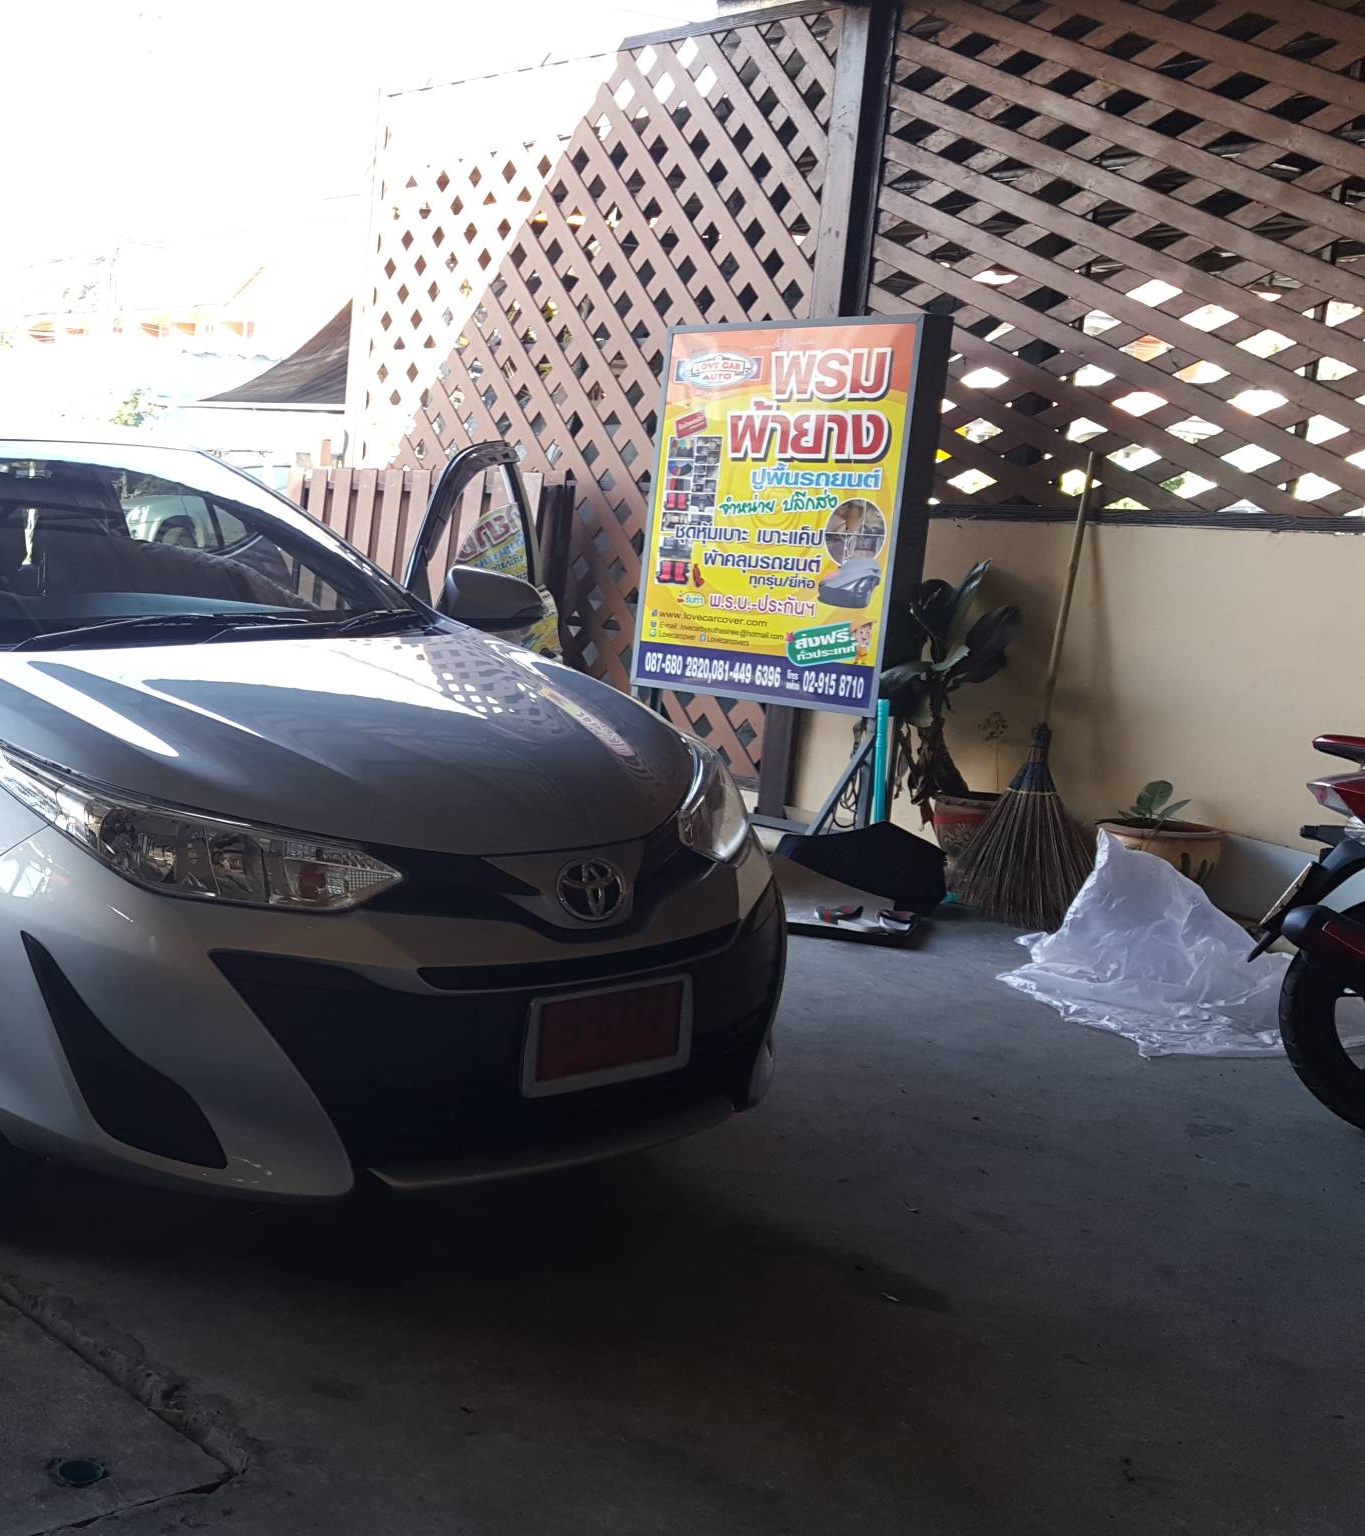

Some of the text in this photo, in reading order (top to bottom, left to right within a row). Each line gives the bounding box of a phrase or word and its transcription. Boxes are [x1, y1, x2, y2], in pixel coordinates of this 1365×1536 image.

[702, 373, 732, 381] AUTO
[772, 348, 891, 400] พรม
[729, 402, 890, 461] ผ้ายาง
[751, 463, 881, 490] ปูพื้นรถยนต์
[719, 489, 838, 515] จำหน่าย ปลีกส่ง
[675, 523, 824, 547] ชุดหุ้มเบาะ เบาะแค็ป
[704, 549, 822, 574] ผ้าคลุมรถยนต์
[749, 573, 816, 590] ทุกรุ่น/ยี่ห้อ
[659, 610, 768, 627] www.lovecarcover.com
[797, 642, 859, 661] ทั่วประเทศ
[644, 652, 683, 675] 087-680
[755, 666, 781, 688] 6396
[802, 670, 865, 699] 02-915 8710
